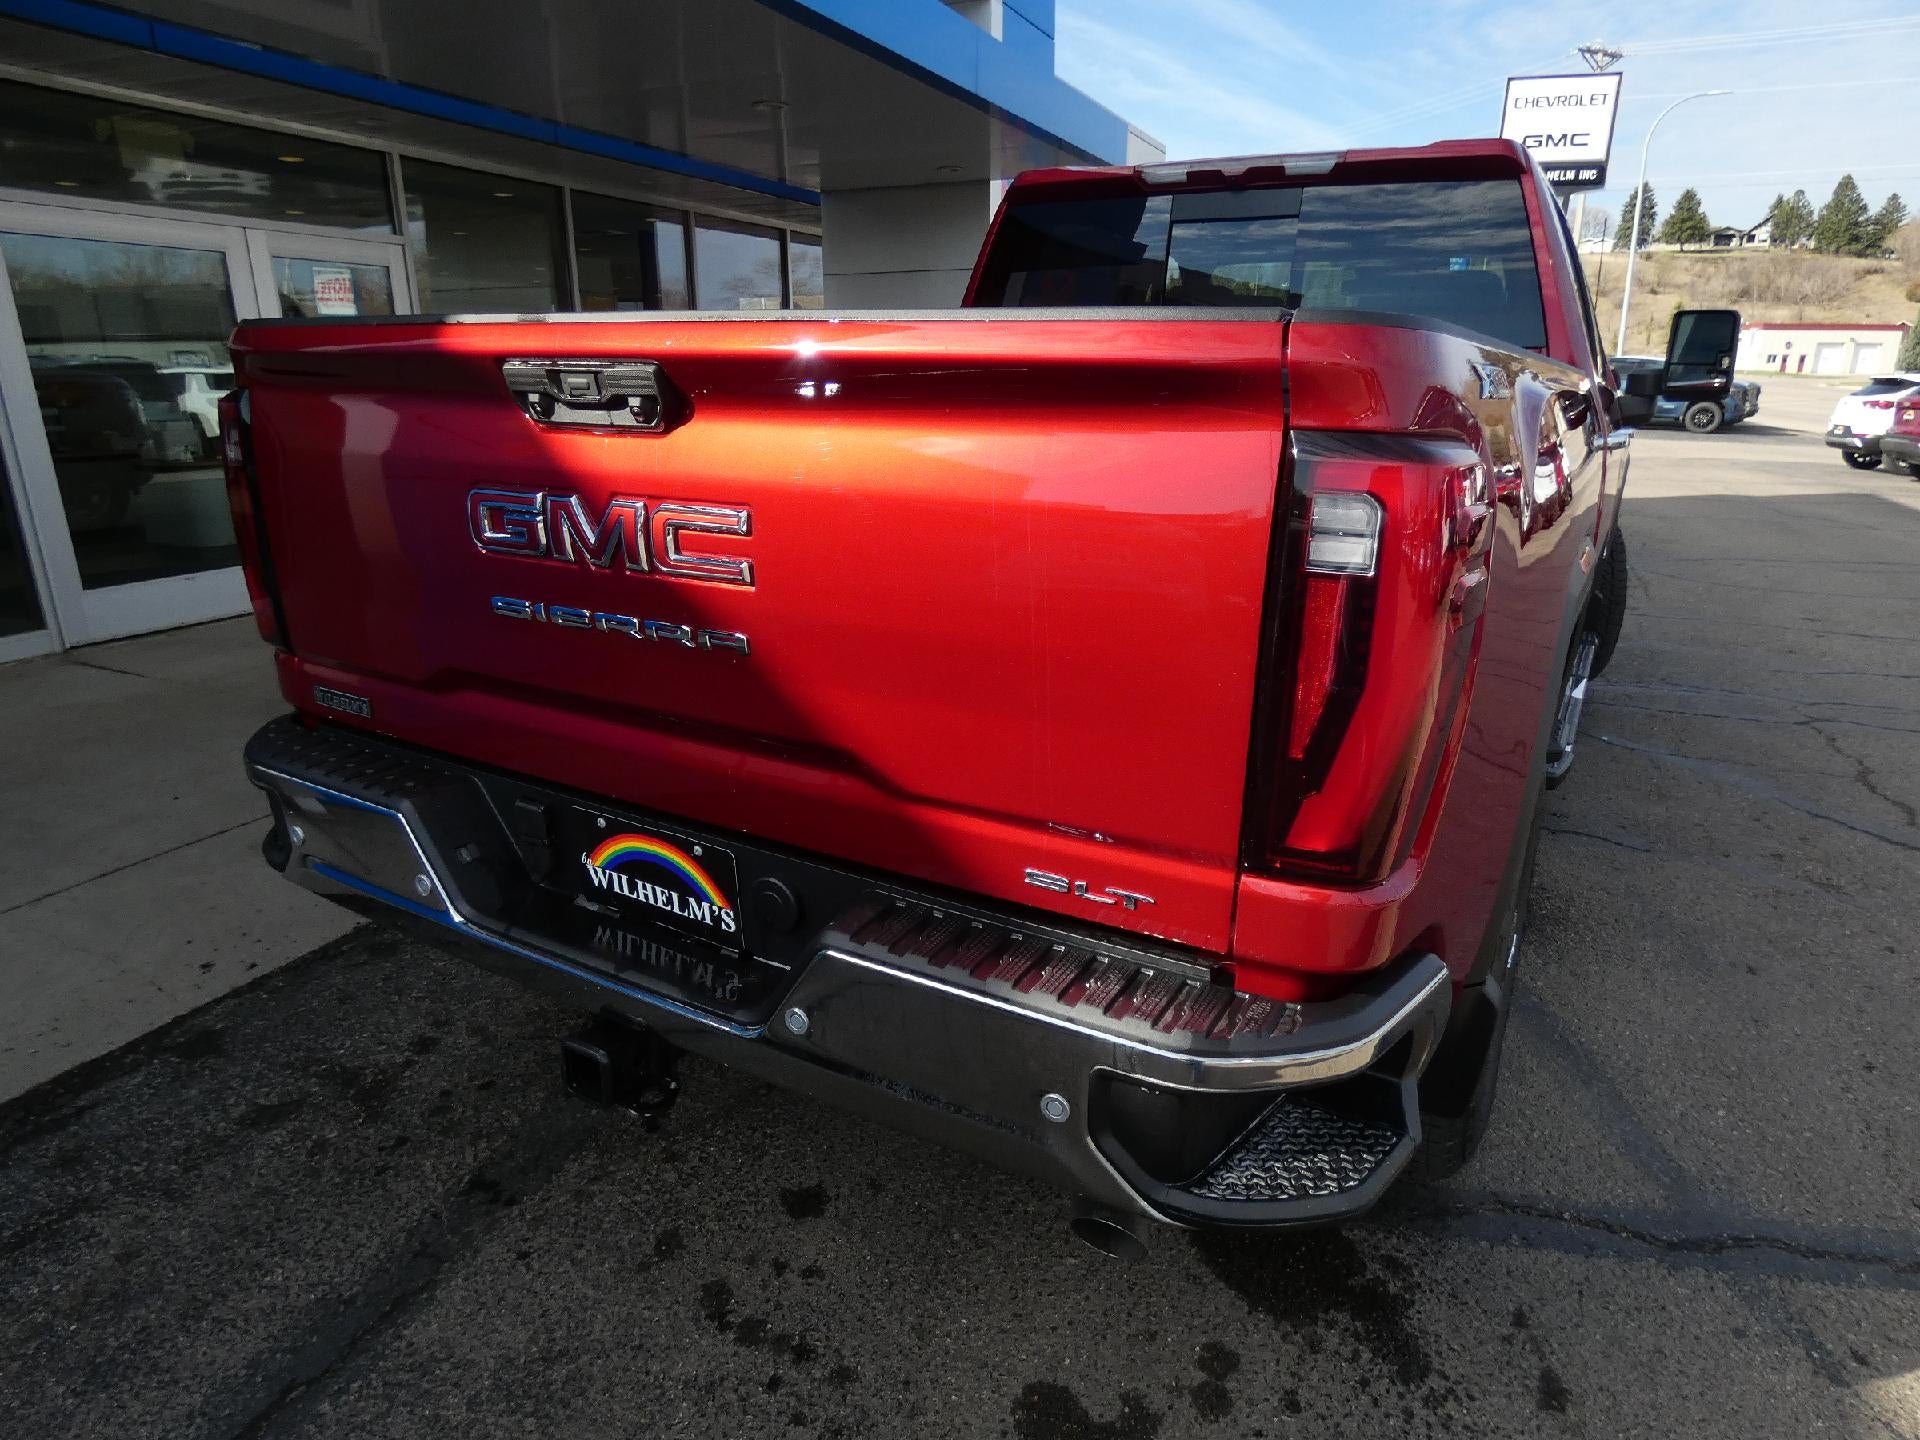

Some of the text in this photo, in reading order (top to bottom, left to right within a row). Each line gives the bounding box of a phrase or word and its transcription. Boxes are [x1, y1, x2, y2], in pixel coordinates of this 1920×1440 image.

[1514, 93, 1608, 109] CHEVROLET
[1522, 133, 1590, 149] GMC
[1578, 169, 1598, 180] INC
[467, 487, 754, 587] GMC
[490, 596, 749, 654] SIERRA
[587, 863, 736, 933] WILHELM'S
[1024, 867, 1156, 911] SLT
